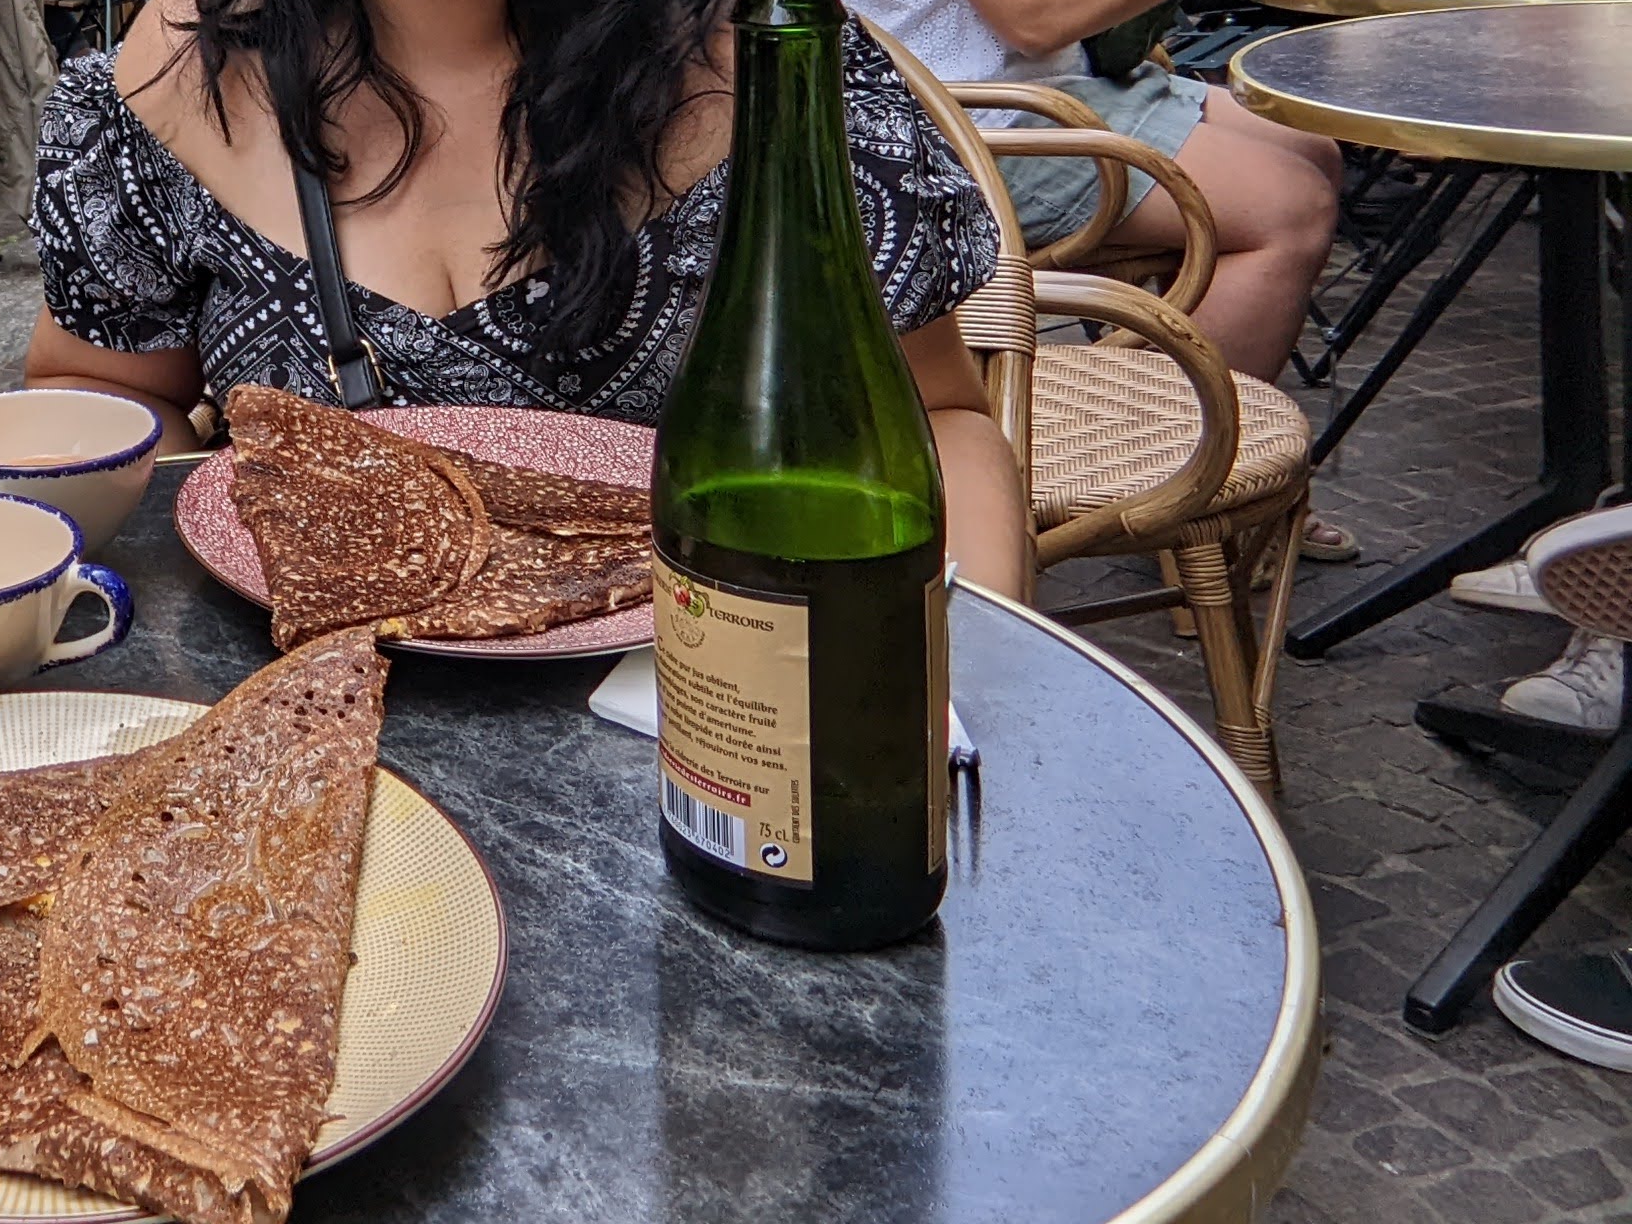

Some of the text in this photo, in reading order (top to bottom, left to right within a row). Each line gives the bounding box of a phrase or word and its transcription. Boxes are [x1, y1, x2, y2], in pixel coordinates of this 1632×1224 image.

[708, 607, 774, 632] TERROIRS
[692, 668, 704, 680] jus
[706, 674, 740, 694] obtient,
[706, 702, 746, 722] caractère
[749, 713, 777, 728] fruité
[716, 692, 724, 701] et
[727, 694, 778, 715] l'équilibre
[699, 710, 757, 737] d'amertume.
[696, 736, 739, 760] réjouiront
[741, 754, 758, 765] vos
[762, 757, 787, 771] sens.
[715, 730, 724, 741] et
[726, 735, 753, 750] dorée
[756, 743, 781, 756] ainsi
[700, 764, 714, 777] des
[716, 769, 751, 791] Terroirs
[754, 785, 770, 795] sur
[759, 822, 771, 838] 75
